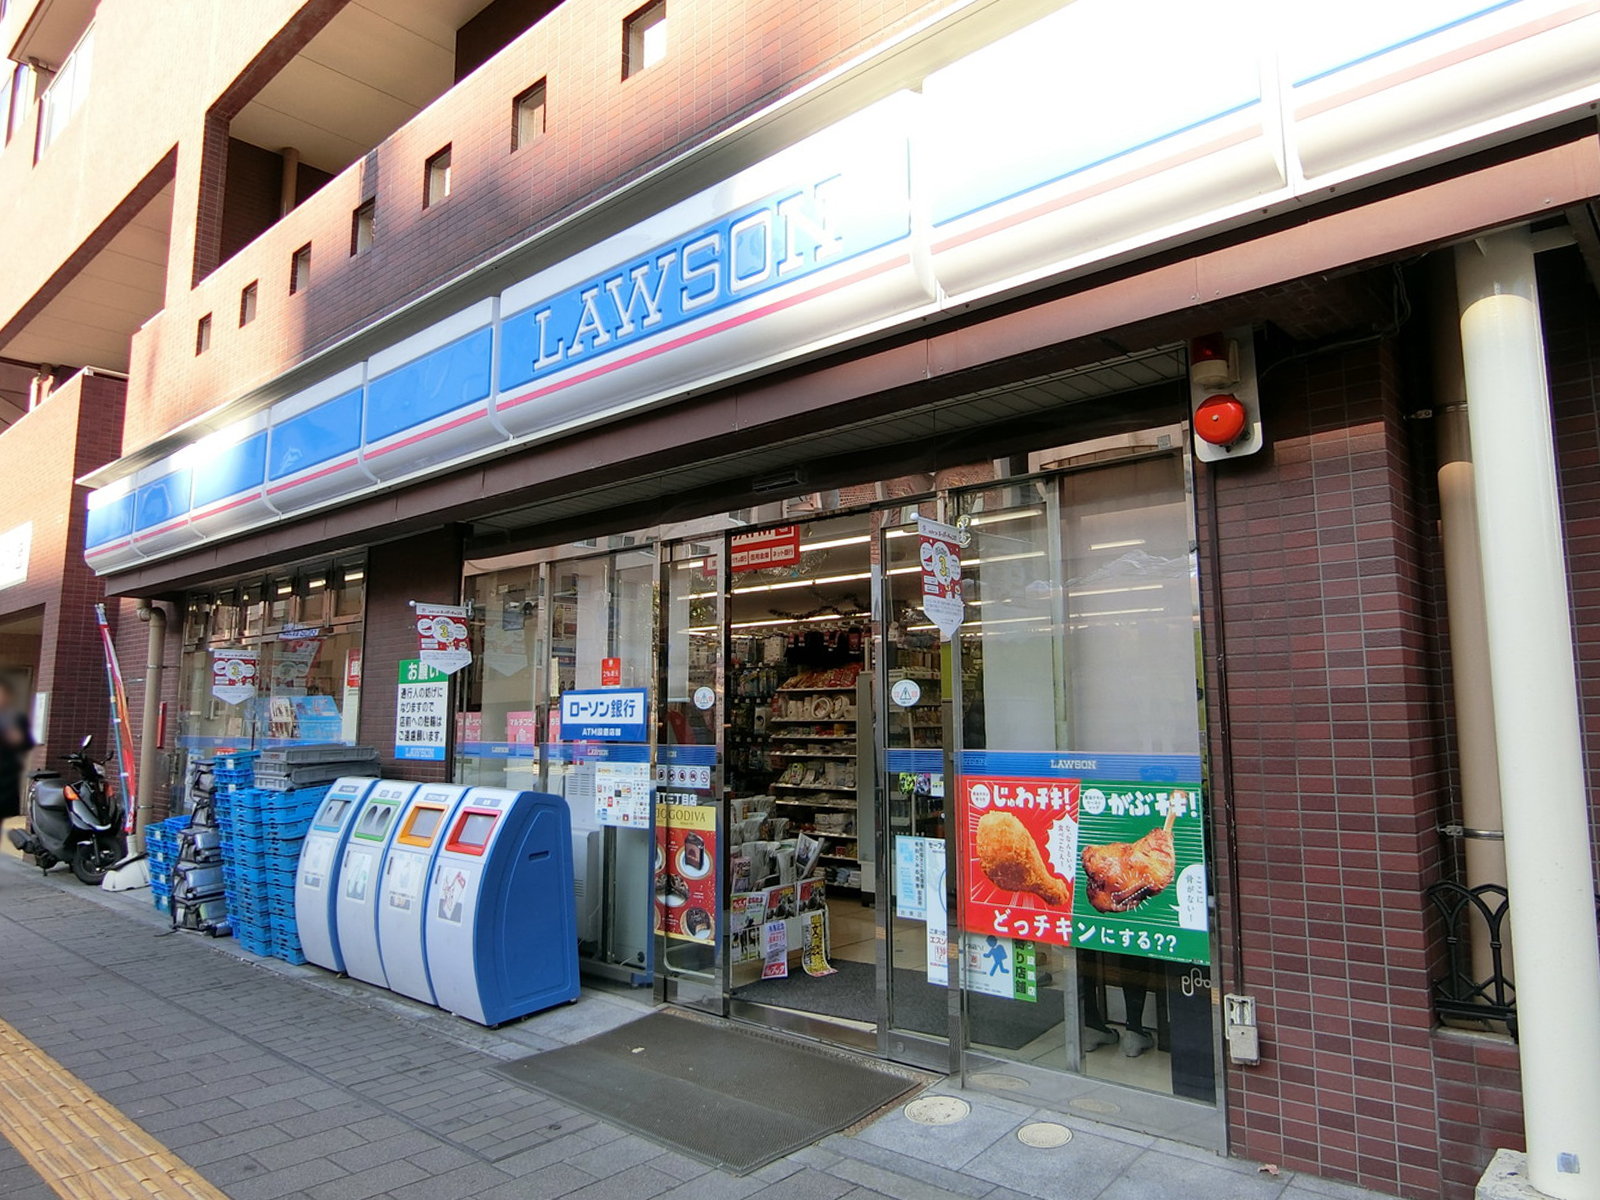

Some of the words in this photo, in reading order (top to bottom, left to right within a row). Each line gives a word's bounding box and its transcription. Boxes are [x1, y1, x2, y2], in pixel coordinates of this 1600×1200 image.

[533, 173, 843, 371] LAWSON
[408, 661, 440, 680] お願い
[401, 687, 443, 699] 通行人の妨げに
[401, 702, 434, 713] なりますので
[569, 699, 636, 717] ローソン銀行
[405, 747, 434, 758] LAWSON
[1050, 758, 1097, 769] LAWSON
[669, 809, 706, 822] GODIVA
